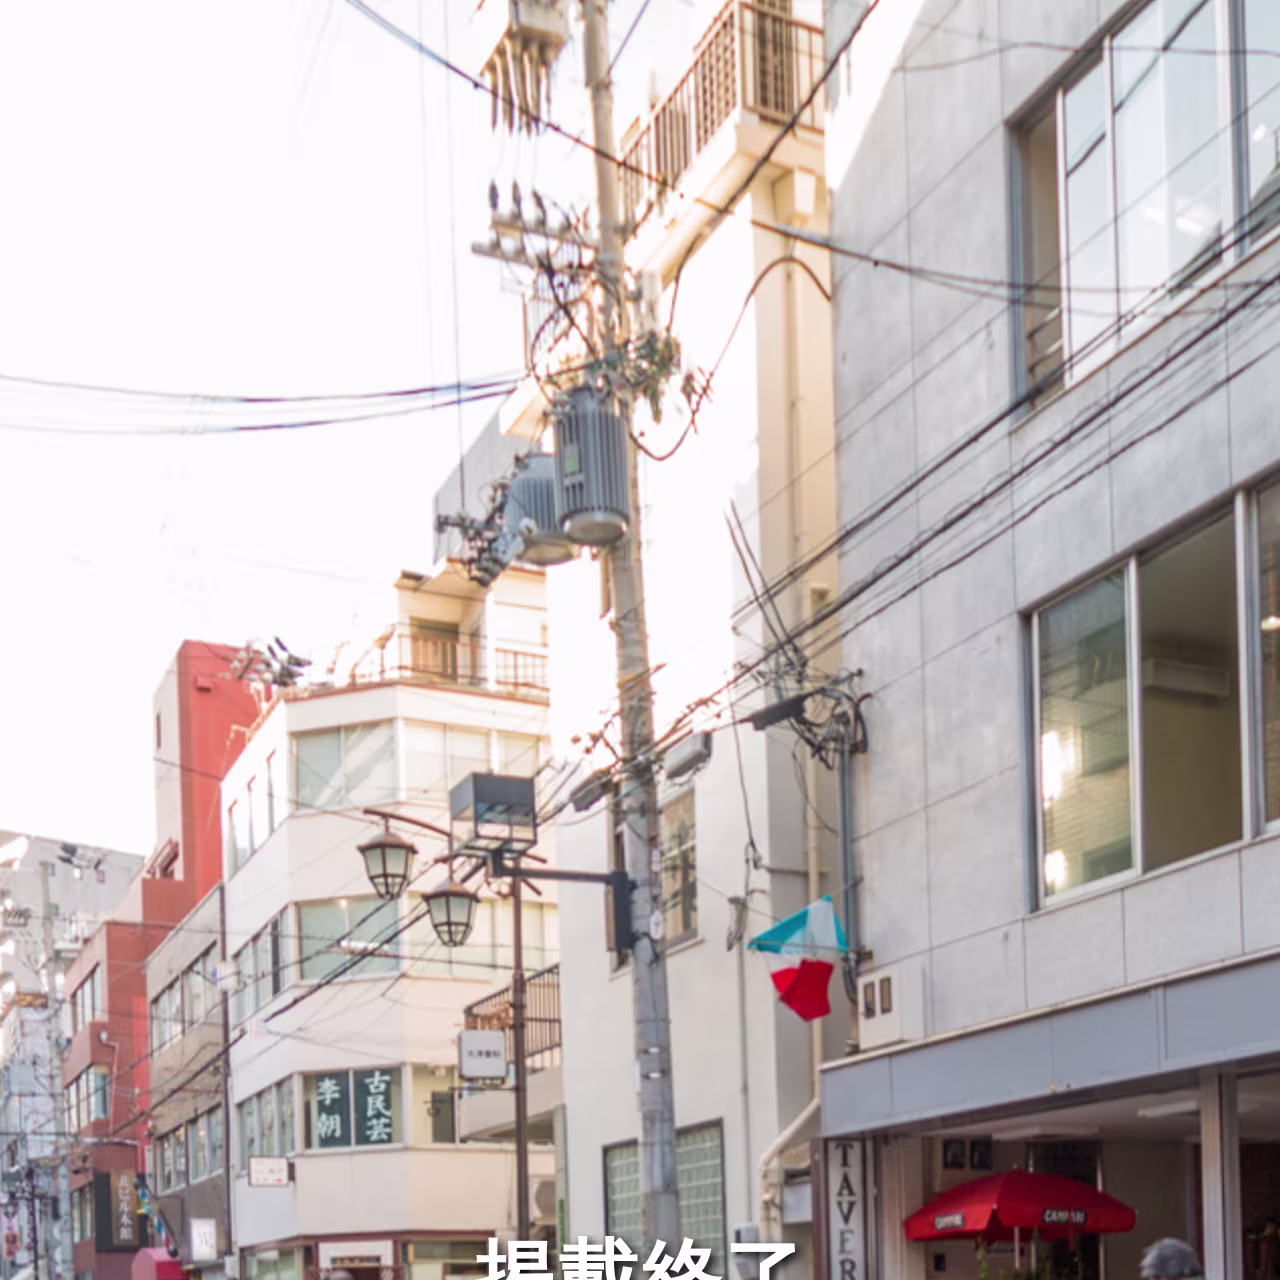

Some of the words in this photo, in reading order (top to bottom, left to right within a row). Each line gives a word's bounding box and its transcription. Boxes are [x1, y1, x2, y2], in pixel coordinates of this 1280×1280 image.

[317, 1077, 342, 1140] 李朝
[364, 1070, 392, 1142] 古民芸
